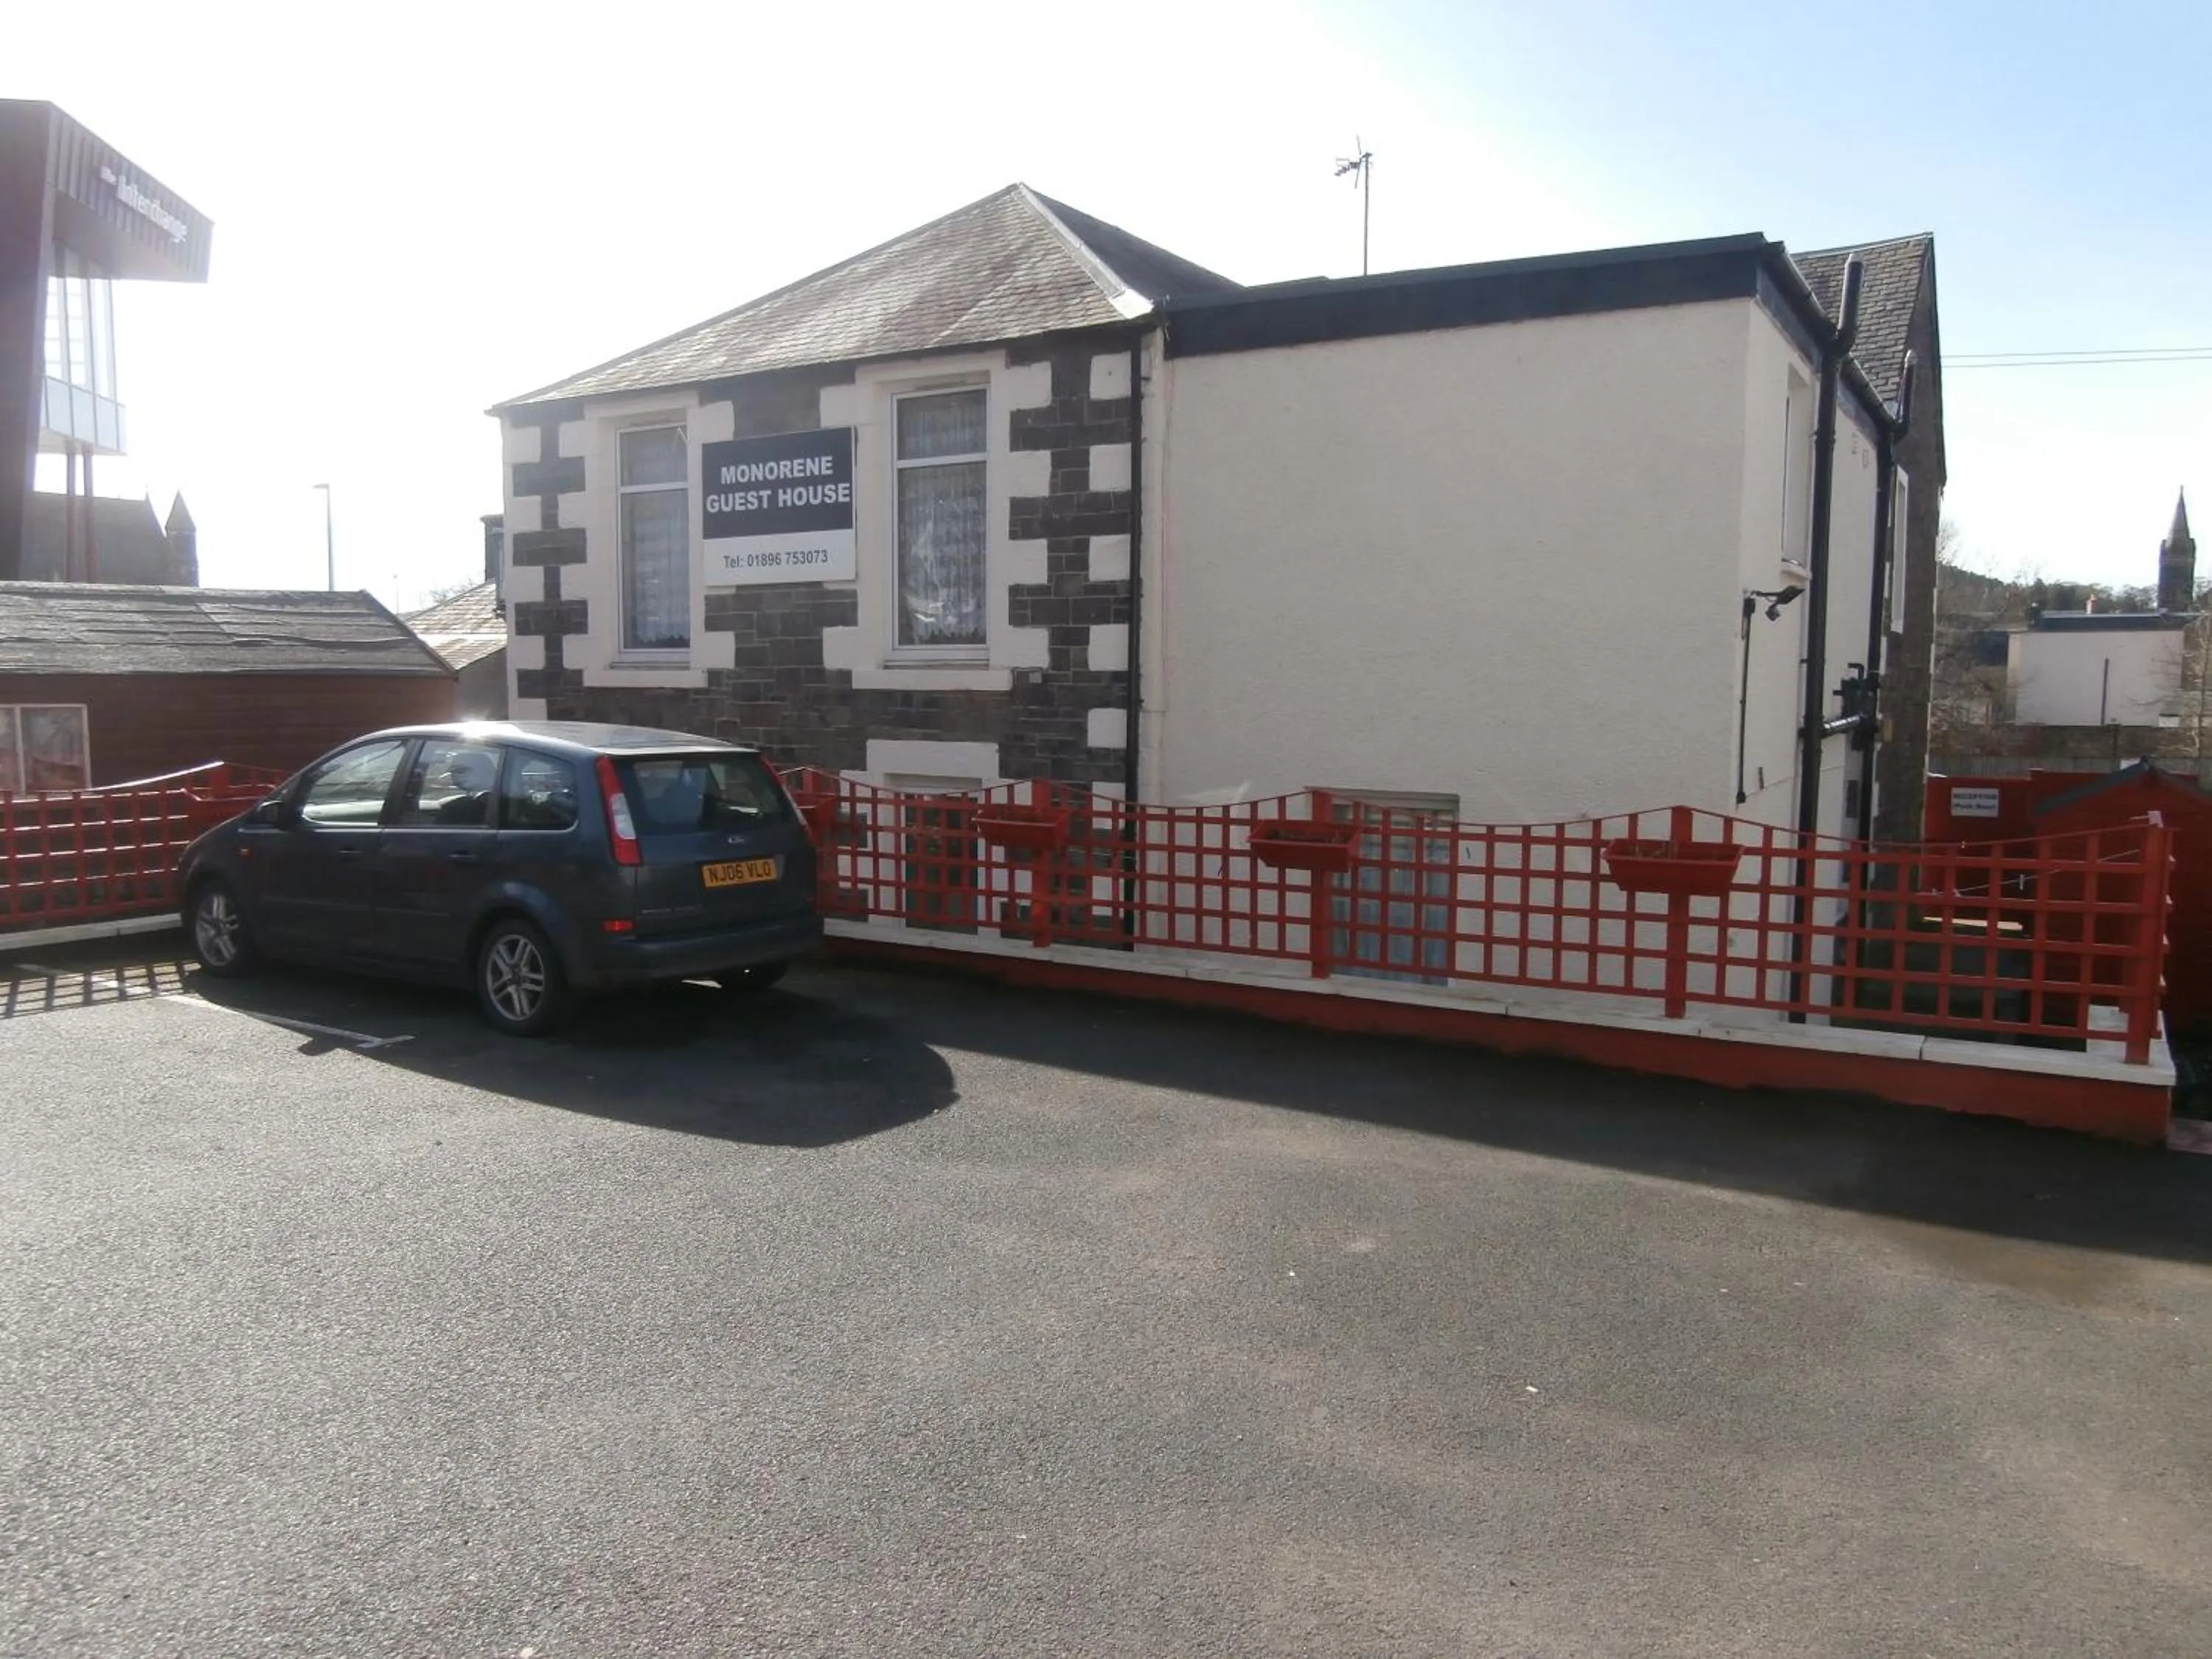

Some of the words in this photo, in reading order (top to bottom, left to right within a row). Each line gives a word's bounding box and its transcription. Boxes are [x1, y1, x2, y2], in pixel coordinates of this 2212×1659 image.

[720, 456, 834, 484] MONORENE
[706, 490, 772, 513] GUEST
[778, 483, 851, 507] HOUSE
[723, 554, 744, 568] Tel:
[746, 553, 782, 567] 01896
[786, 549, 828, 565] 753073
[707, 864, 744, 883] NJ06
[746, 860, 771, 878] VLO
